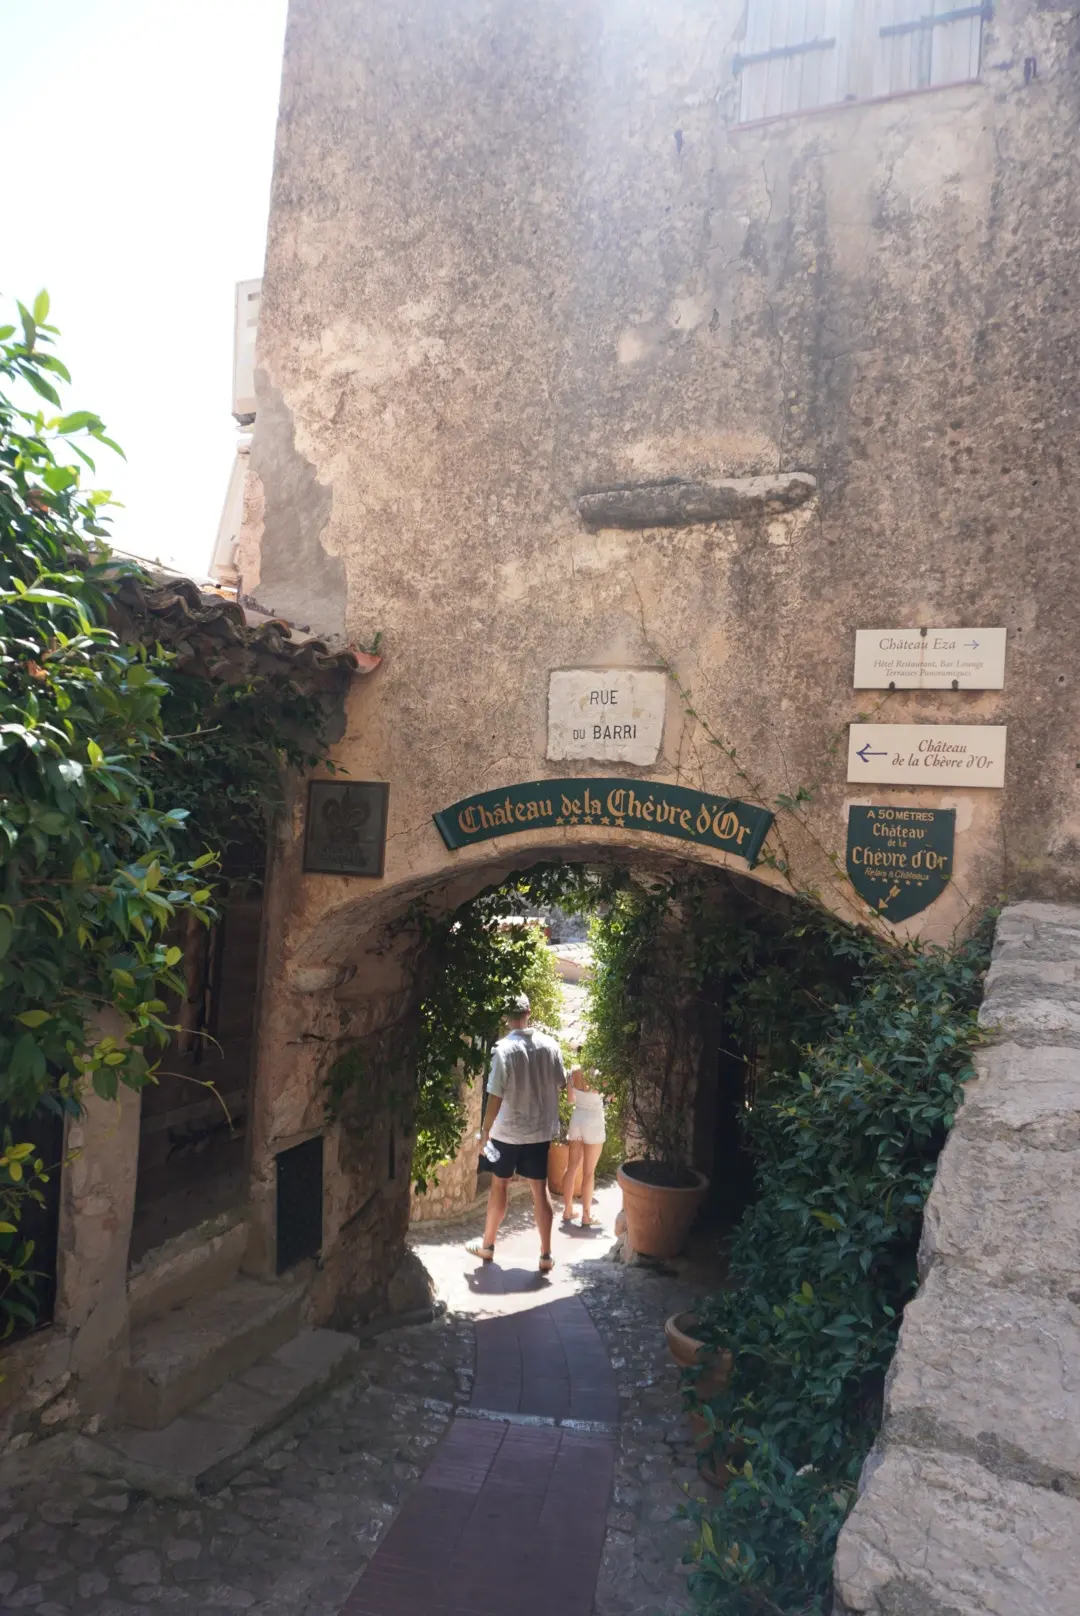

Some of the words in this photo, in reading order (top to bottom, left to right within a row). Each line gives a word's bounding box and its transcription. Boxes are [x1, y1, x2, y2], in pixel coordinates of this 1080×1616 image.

[879, 637, 928, 650] Château
[933, 638, 956, 650] Eza
[940, 659, 953, 668] Bar
[590, 690, 619, 705] RUE
[573, 730, 585, 740] DU
[593, 724, 637, 740] BARRI
[918, 739, 967, 753] Château
[892, 753, 904, 766] de
[908, 754, 919, 767] la
[924, 755, 963, 768] Chèvre
[966, 755, 993, 769] d'Or
[458, 797, 554, 834] Château
[607, 788, 693, 832] Chèvre
[867, 810, 876, 818] A
[878, 810, 895, 819] 50
[887, 839, 896, 847] de
[899, 839, 907, 848] la
